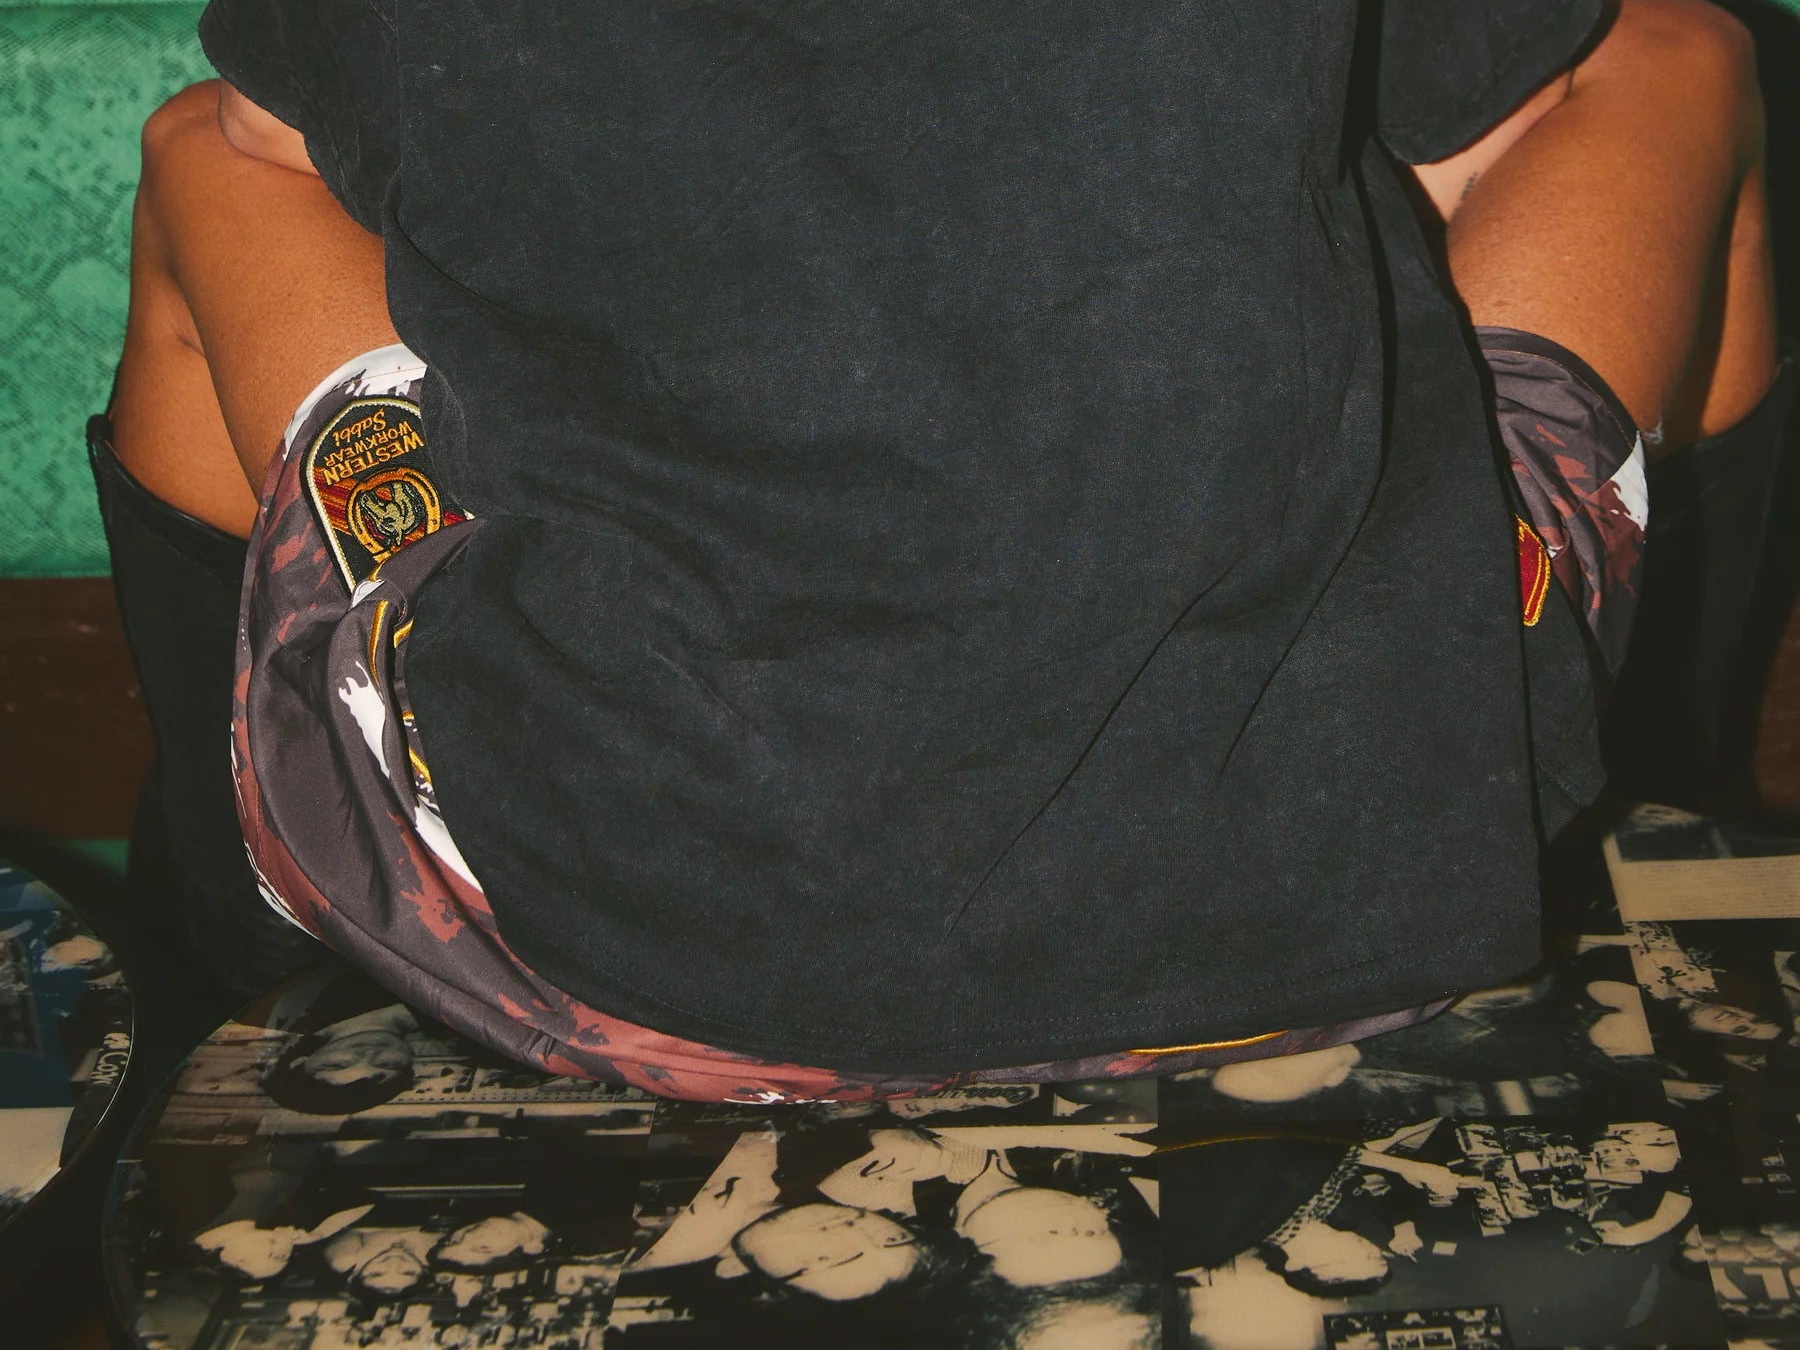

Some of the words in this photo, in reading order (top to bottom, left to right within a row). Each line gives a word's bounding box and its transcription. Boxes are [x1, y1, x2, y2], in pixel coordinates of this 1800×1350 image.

[324, 421, 413, 466] WORKWEAR
[332, 408, 386, 446] Sabbi
[322, 432, 424, 486] WESTERN
